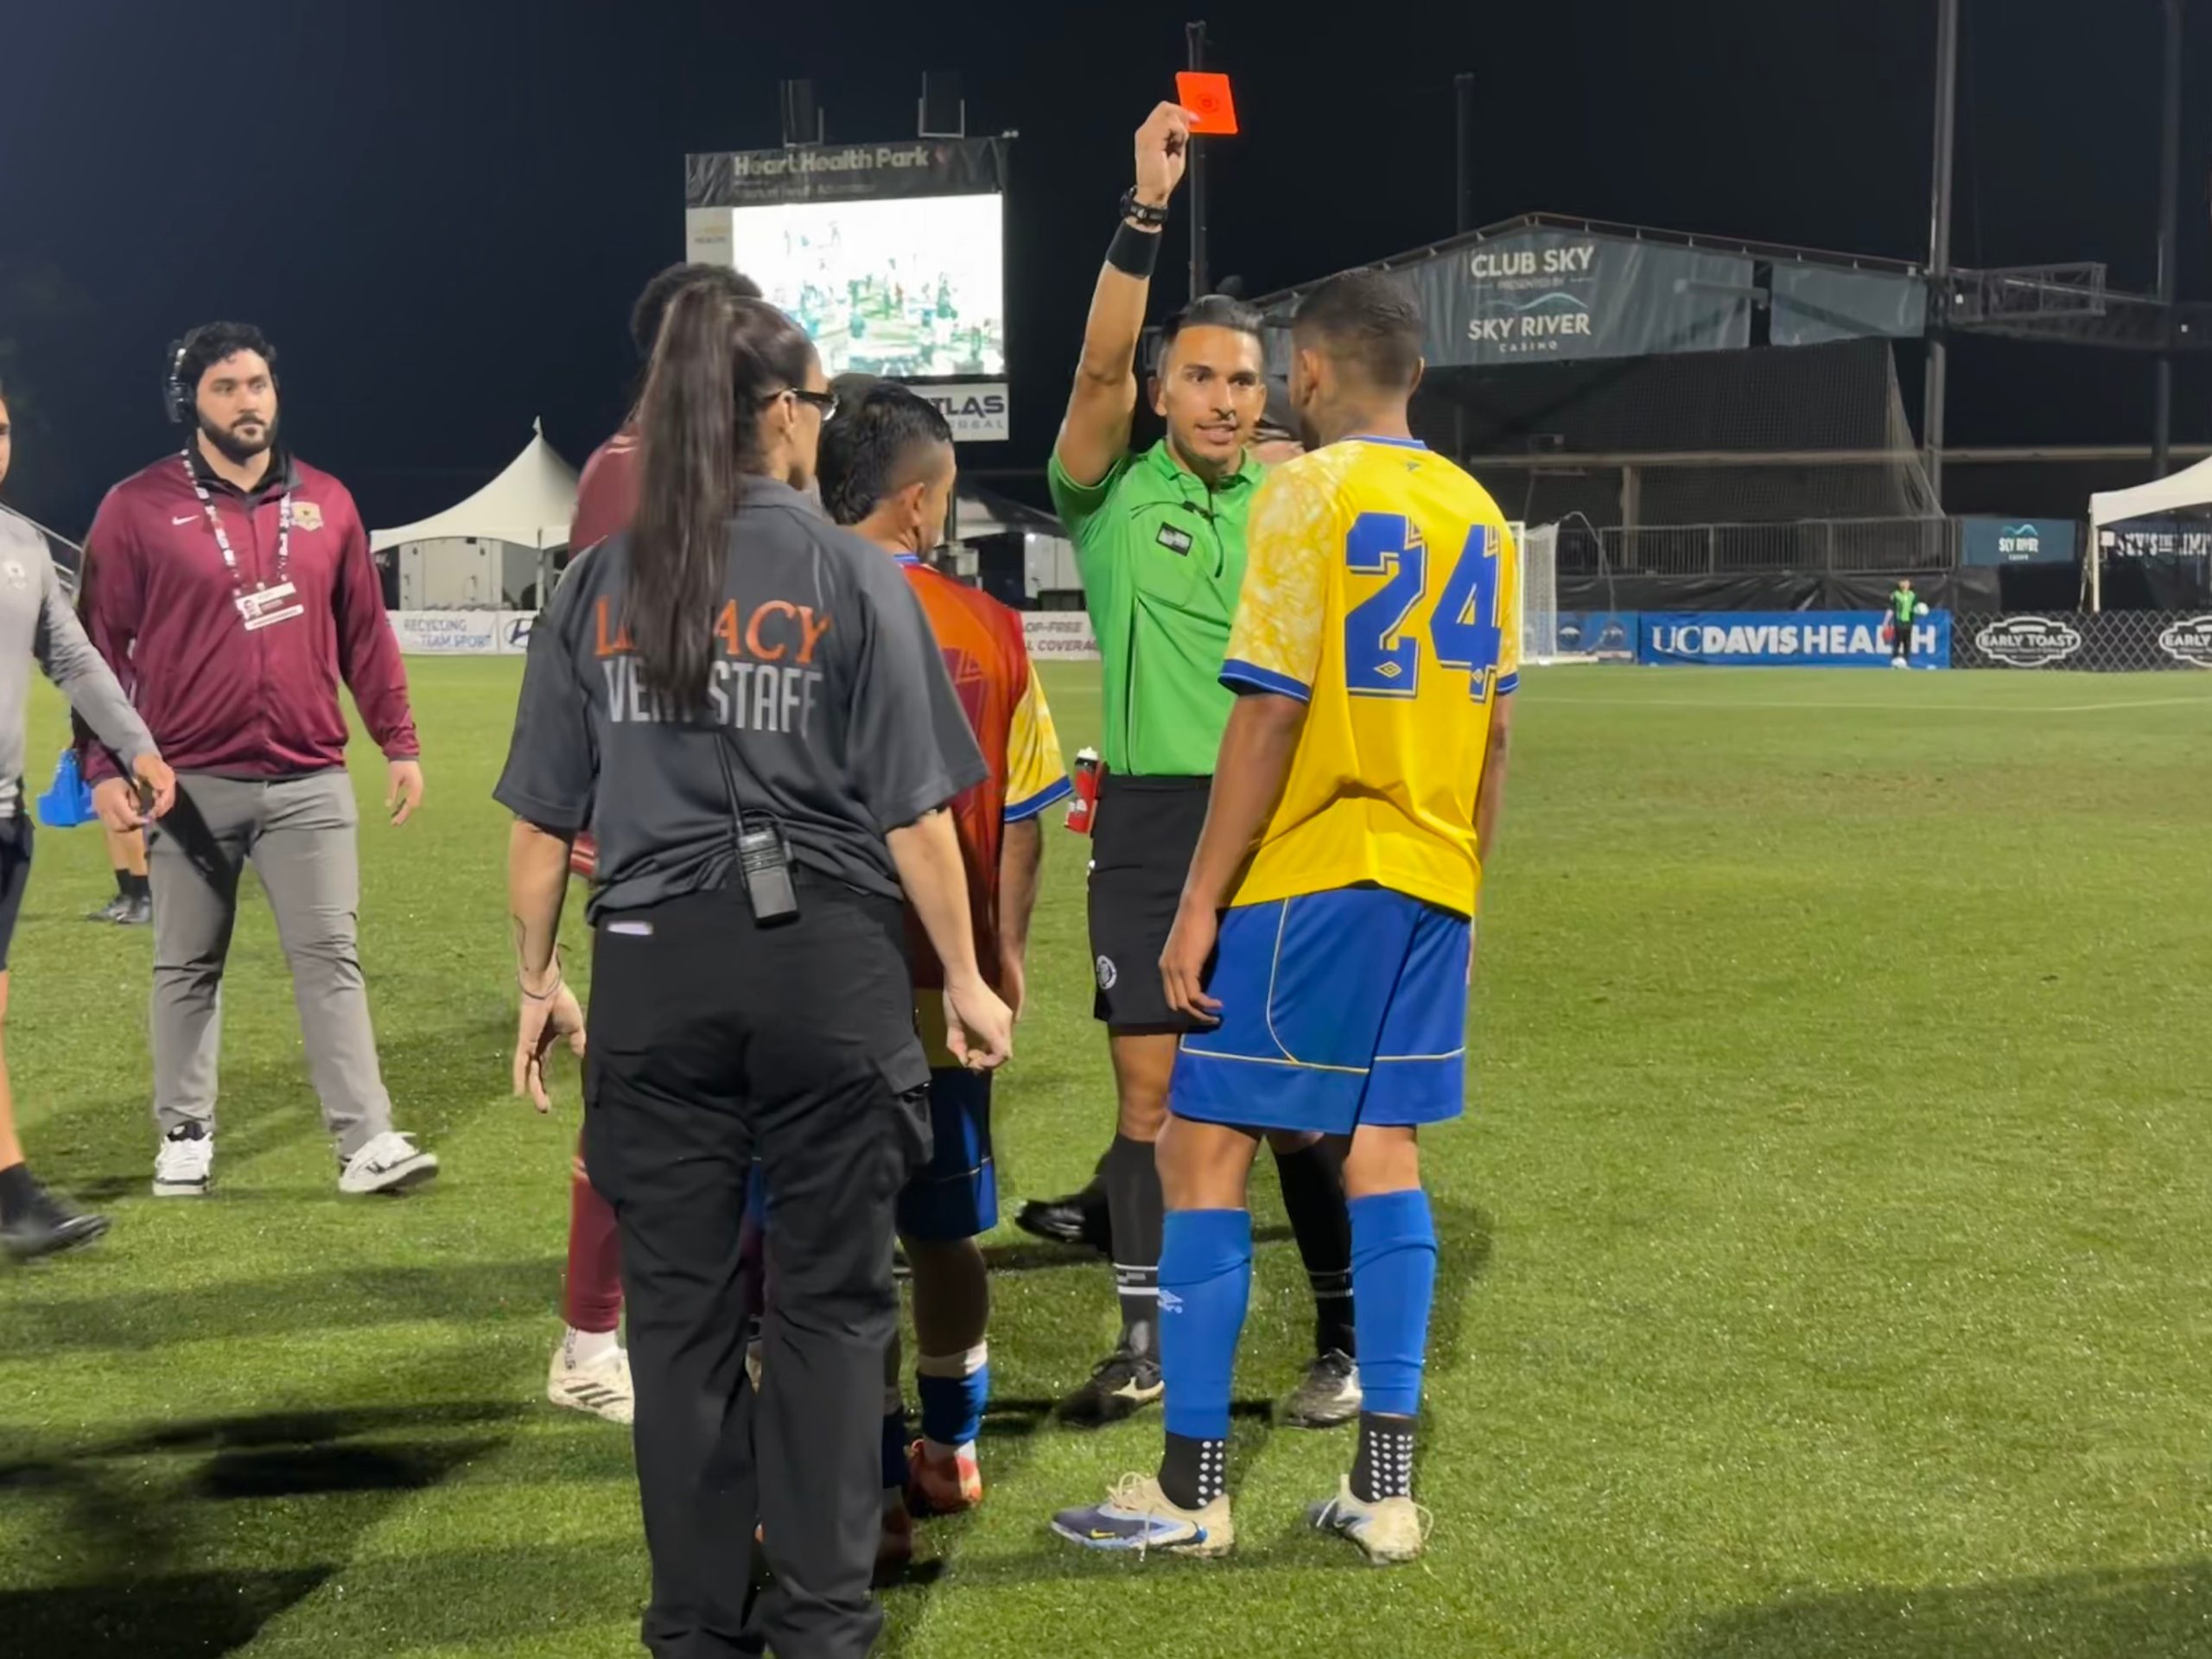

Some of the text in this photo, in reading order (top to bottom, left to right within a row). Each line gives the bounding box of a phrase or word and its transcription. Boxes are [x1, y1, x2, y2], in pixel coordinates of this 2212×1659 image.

[801, 149, 872, 172] Health
[875, 146, 930, 169] Park
[1471, 245, 1595, 278] CLUB SKY
[1467, 313, 1592, 341] SKY RIVER
[1498, 340, 1559, 353] CASINO
[930, 395, 1005, 418] TLAS
[1999, 537, 2015, 552] SKY
[1344, 512, 1502, 703] 24
[404, 619, 467, 632] RECYCLING
[594, 594, 831, 664] LACY
[419, 634, 492, 647] TEAM SPORT
[1038, 639, 1098, 652] COVERA
[1804, 625, 1936, 654] HEALH
[1981, 633, 2074, 647] EARLY TOAST
[2164, 633, 2212, 647] EARLY
[709, 659, 824, 736] STAFF
